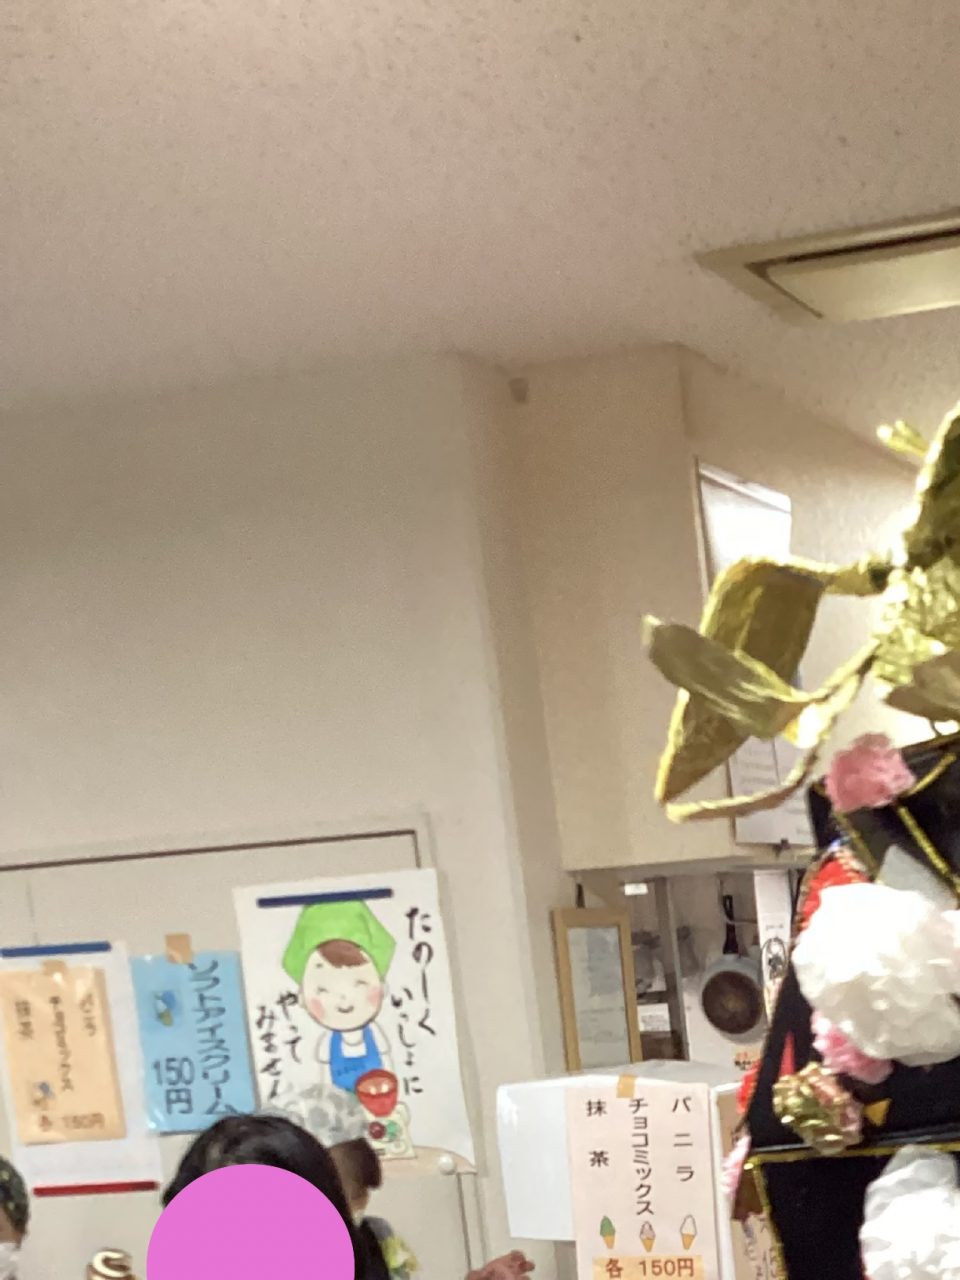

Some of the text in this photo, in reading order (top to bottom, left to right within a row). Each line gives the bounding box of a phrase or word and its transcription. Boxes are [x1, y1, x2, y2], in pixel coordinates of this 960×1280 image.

[585, 1099, 610, 1168] 抹茶
[628, 1097, 655, 1216] チョコミックス
[672, 1096, 695, 1183] バニラ
[605, 1257, 695, 1280] 各 150円
